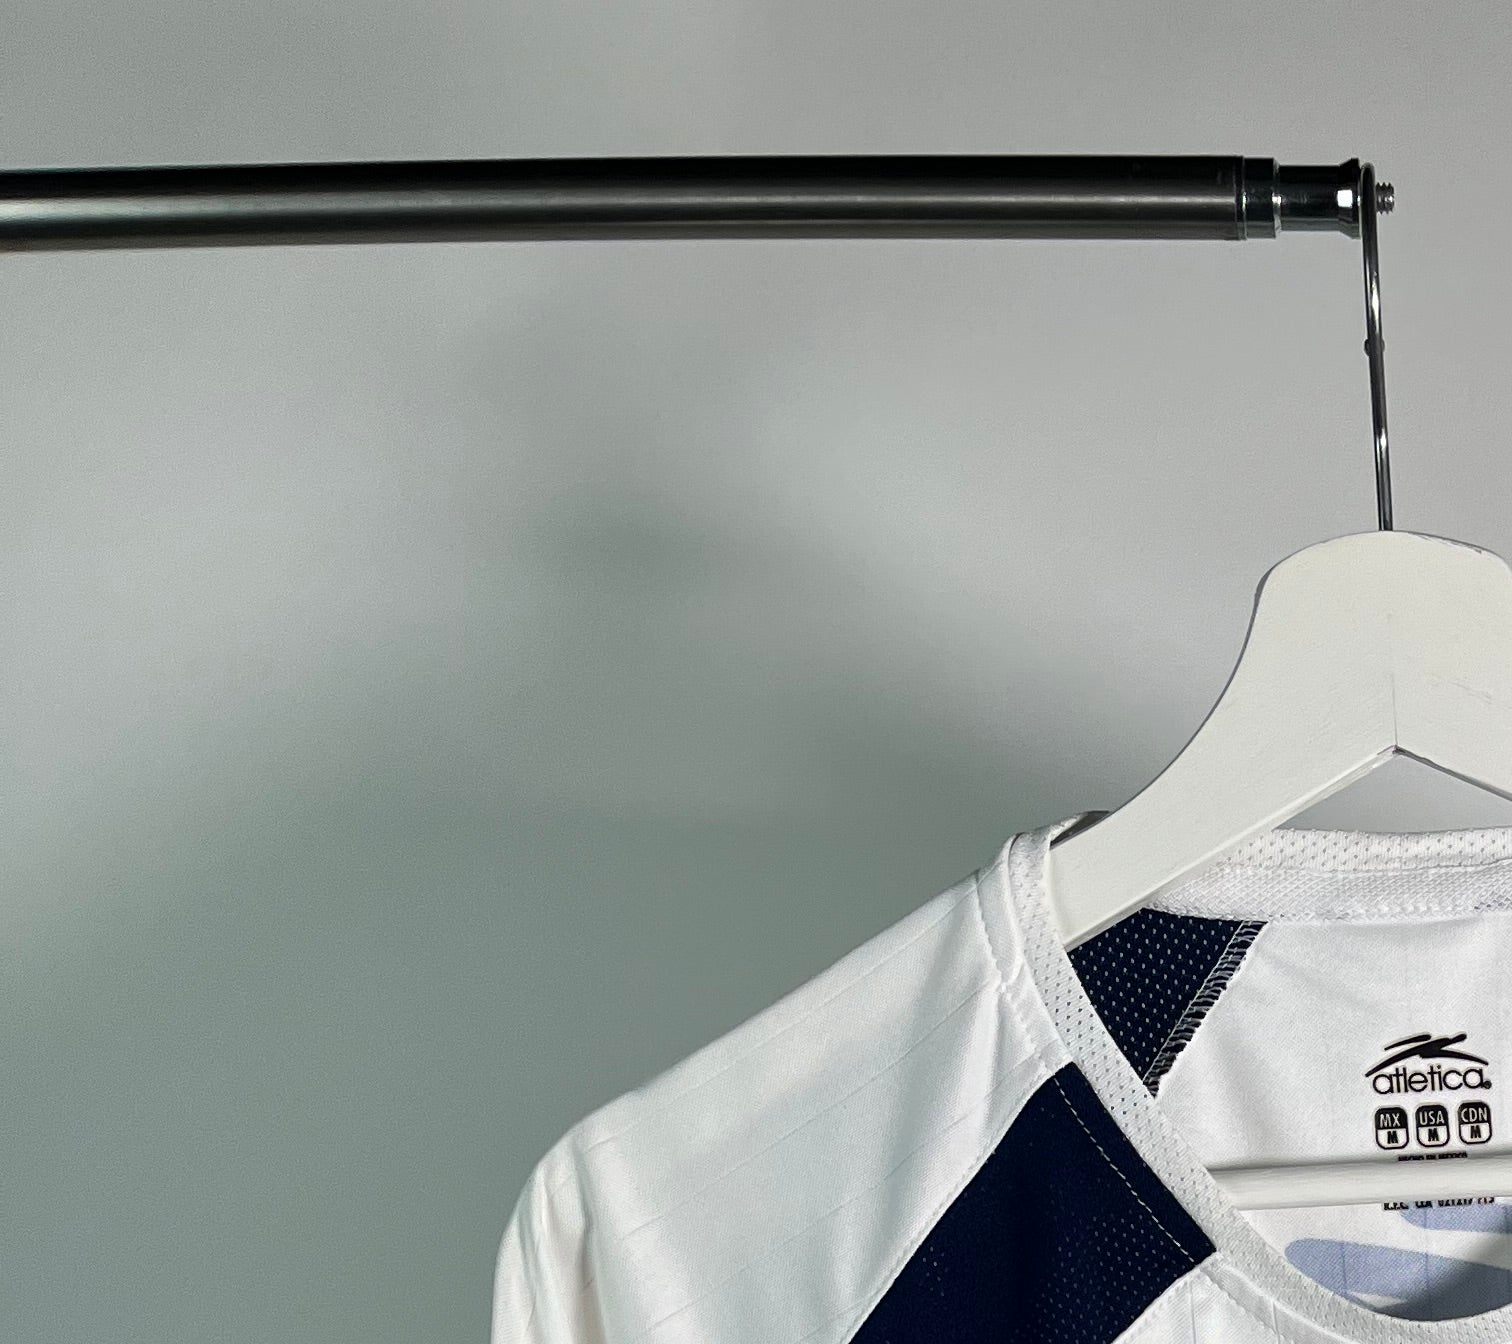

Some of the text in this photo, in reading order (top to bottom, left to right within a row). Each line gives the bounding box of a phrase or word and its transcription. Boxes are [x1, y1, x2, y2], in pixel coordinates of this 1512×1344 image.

[1372, 1064, 1484, 1095] atletica
[1380, 1113, 1401, 1128] MX
[1420, 1110, 1445, 1126] USA
[1461, 1106, 1488, 1123] CDN
[1387, 1130, 1399, 1144] M
[1428, 1127, 1440, 1142] M
[1470, 1124, 1482, 1139] M
